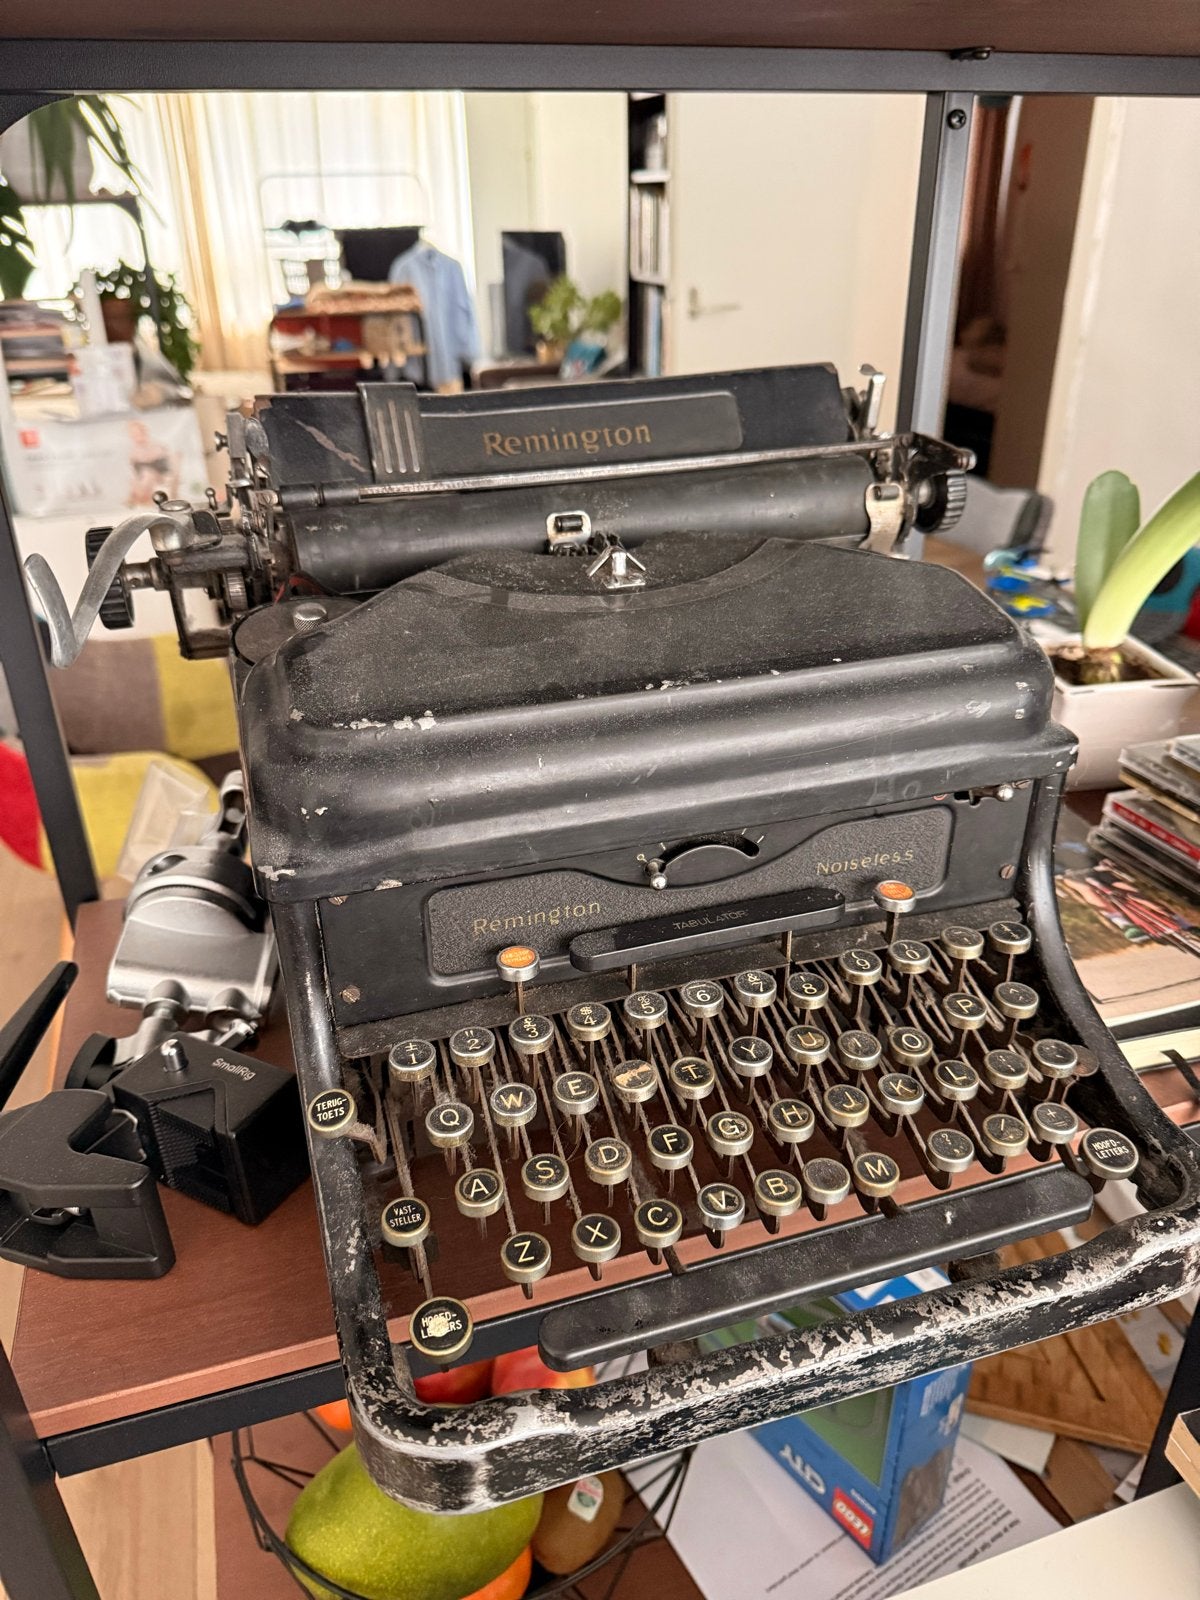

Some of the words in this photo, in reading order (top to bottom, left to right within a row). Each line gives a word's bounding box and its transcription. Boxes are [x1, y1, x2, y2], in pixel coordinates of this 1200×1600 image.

[482, 424, 652, 457] Remington
[816, 849, 915, 876] Noiseless
[472, 902, 601, 936] Remington
[672, 910, 748, 930] TABULATOR
[856, 958, 870, 970] 9
[752, 981, 764, 992] 7
[802, 983, 817, 995] 8
[696, 989, 711, 1002] 6
[641, 1002, 655, 1014] 5
[956, 998, 974, 1014] P
[584, 1015, 598, 1026] 4
[526, 1027, 539, 1038] 3
[797, 1031, 817, 1047] U
[901, 1033, 922, 1049] O
[467, 1038, 482, 1051] 2
[740, 1043, 757, 1058] Y
[408, 1053, 418, 1065] 1
[212, 1057, 257, 1081] SmallRig
[681, 1063, 699, 1080] T
[944, 1065, 967, 1081] L
[567, 1079, 587, 1096] E
[889, 1079, 914, 1095] K
[315, 1097, 348, 1112] TERUG-
[500, 1091, 523, 1109] W
[842, 1091, 857, 1110] J
[317, 1107, 345, 1122] TOETS
[439, 1108, 460, 1126] Q
[781, 1104, 803, 1123] H
[718, 1117, 740, 1136] G
[663, 1132, 678, 1151] F
[598, 1145, 619, 1164] D
[1095, 1144, 1130, 1160] LETTERS
[535, 1160, 555, 1180] S
[864, 1159, 890, 1179] M
[470, 1177, 490, 1198] A
[766, 1176, 789, 1196] B
[707, 1190, 727, 1210] V
[393, 1205, 417, 1217] VAST-
[647, 1206, 669, 1226] C
[389, 1212, 422, 1228] STELLER
[585, 1221, 608, 1243] X
[514, 1240, 535, 1264] Z
[778, 1444, 826, 1495] CITY
[835, 1499, 869, 1535] LEGO
